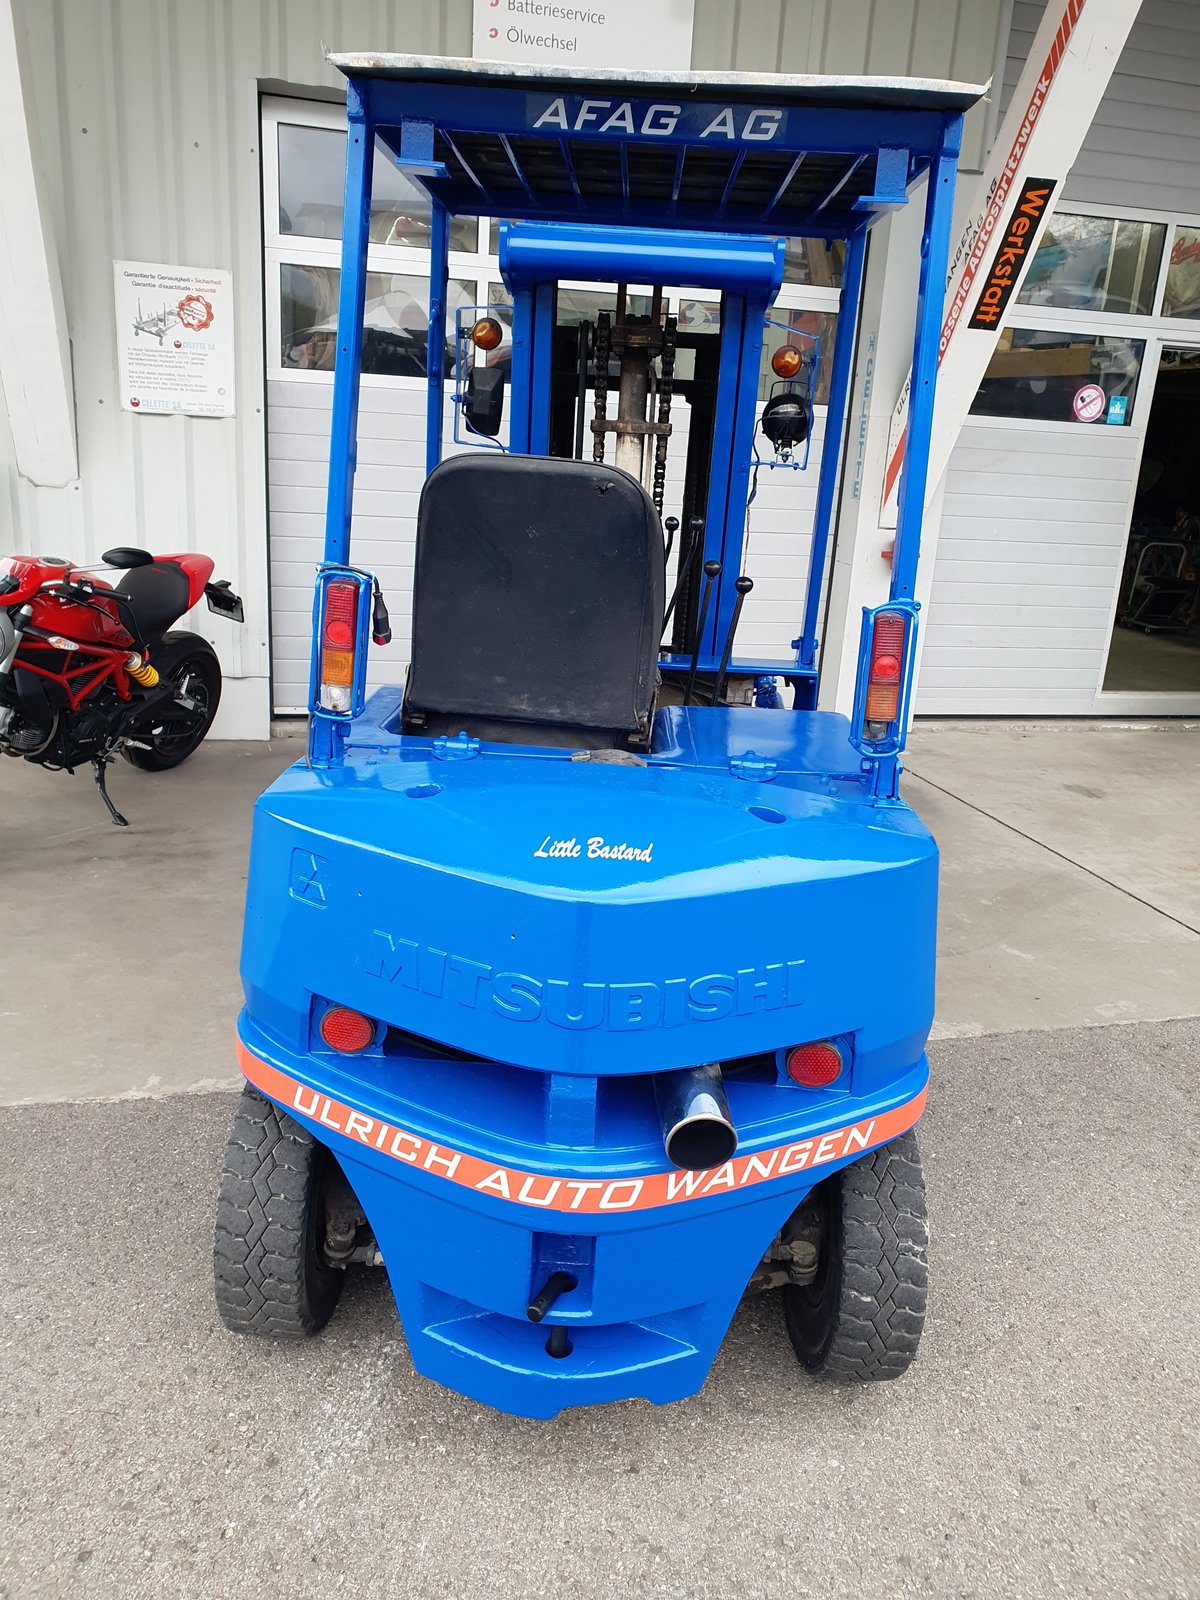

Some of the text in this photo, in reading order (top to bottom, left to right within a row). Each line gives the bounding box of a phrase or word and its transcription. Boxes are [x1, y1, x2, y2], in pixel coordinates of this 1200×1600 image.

[508, 0, 605, 24] Batterieservice
[507, 26, 577, 51] Ölwechsel
[532, 98, 783, 141] AFAG AG
[986, 178, 997, 208] AG
[938, 77, 1050, 361] osserie Autospritzwerk
[976, 188, 1049, 324] Werkstatt
[131, 280, 156, 288] Garantie
[897, 219, 973, 415] ULR ANGEN
[183, 341, 206, 350] CELETTE
[142, 399, 170, 409] CELETTE
[853, 358, 873, 498] CELETTE
[533, 835, 654, 863] Little Bastard
[364, 929, 806, 1033] MITSUBISHI
[293, 1085, 875, 1209] ULRICH AUTO WANGEN
